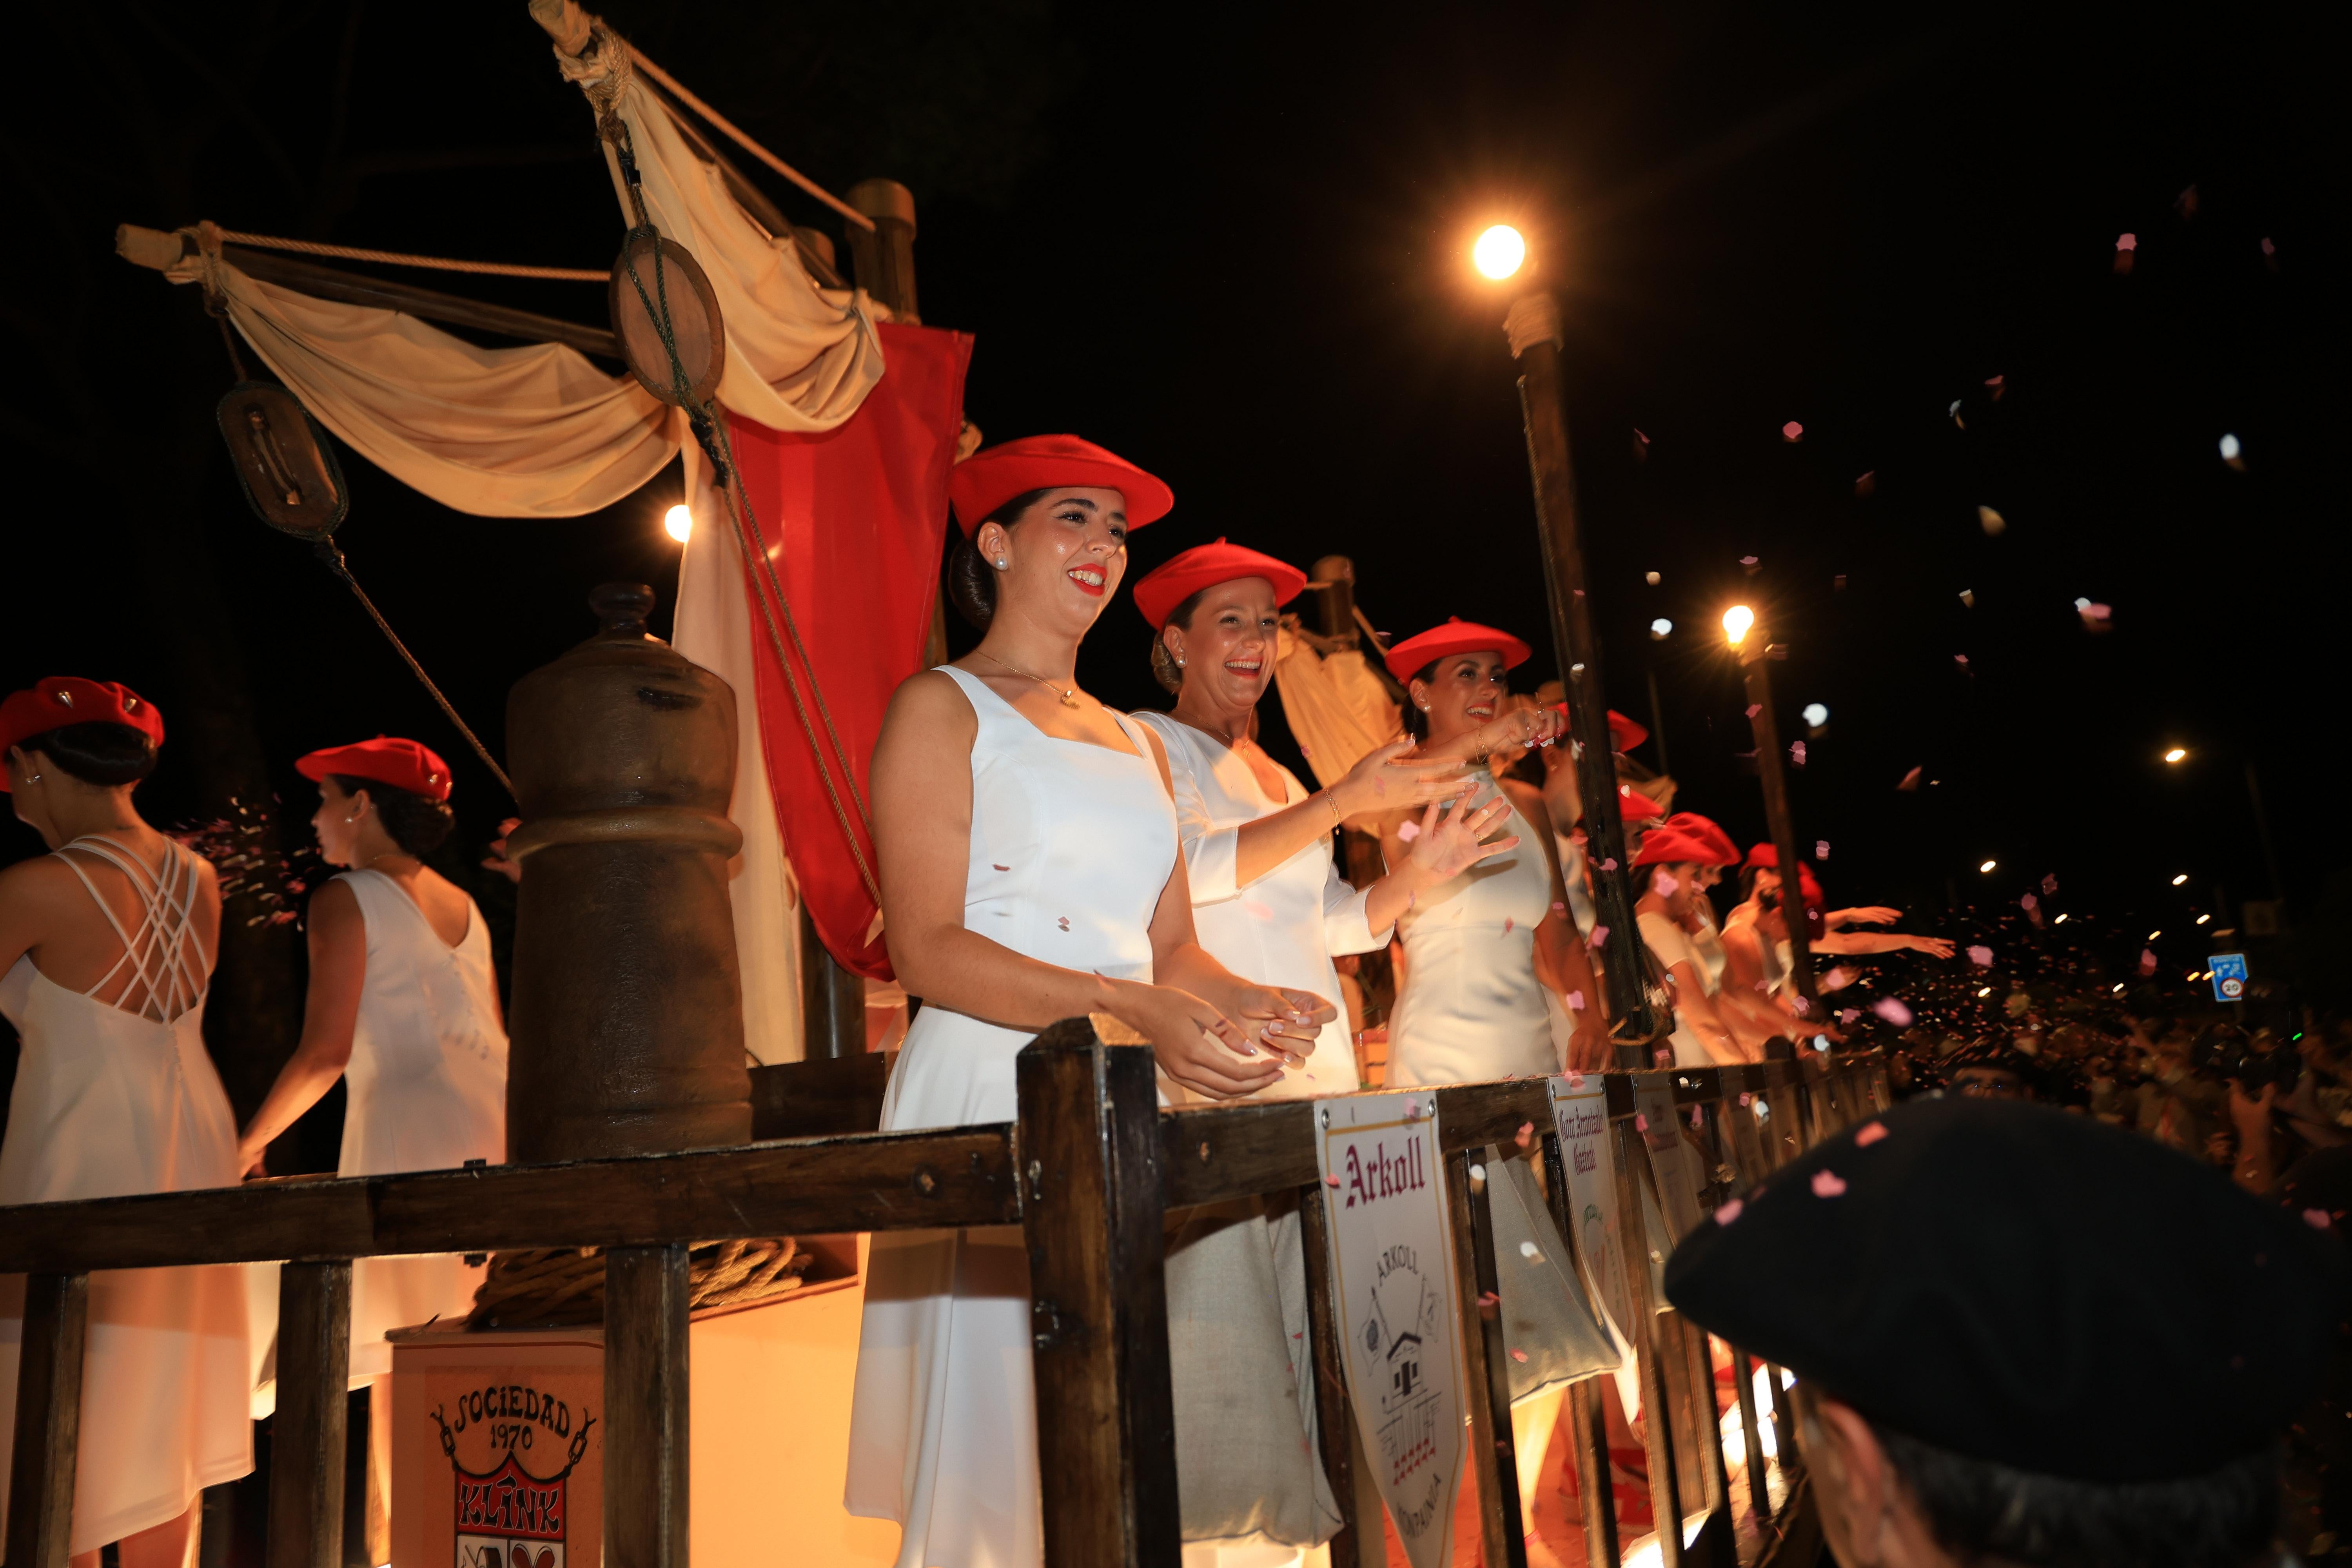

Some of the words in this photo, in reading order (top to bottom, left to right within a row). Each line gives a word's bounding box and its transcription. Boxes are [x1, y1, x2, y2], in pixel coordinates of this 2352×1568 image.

[1345, 1135, 1426, 1210] Arkoll
[1376, 1244, 1419, 1287] ARKOLL
[490, 1424, 532, 1450] 1970
